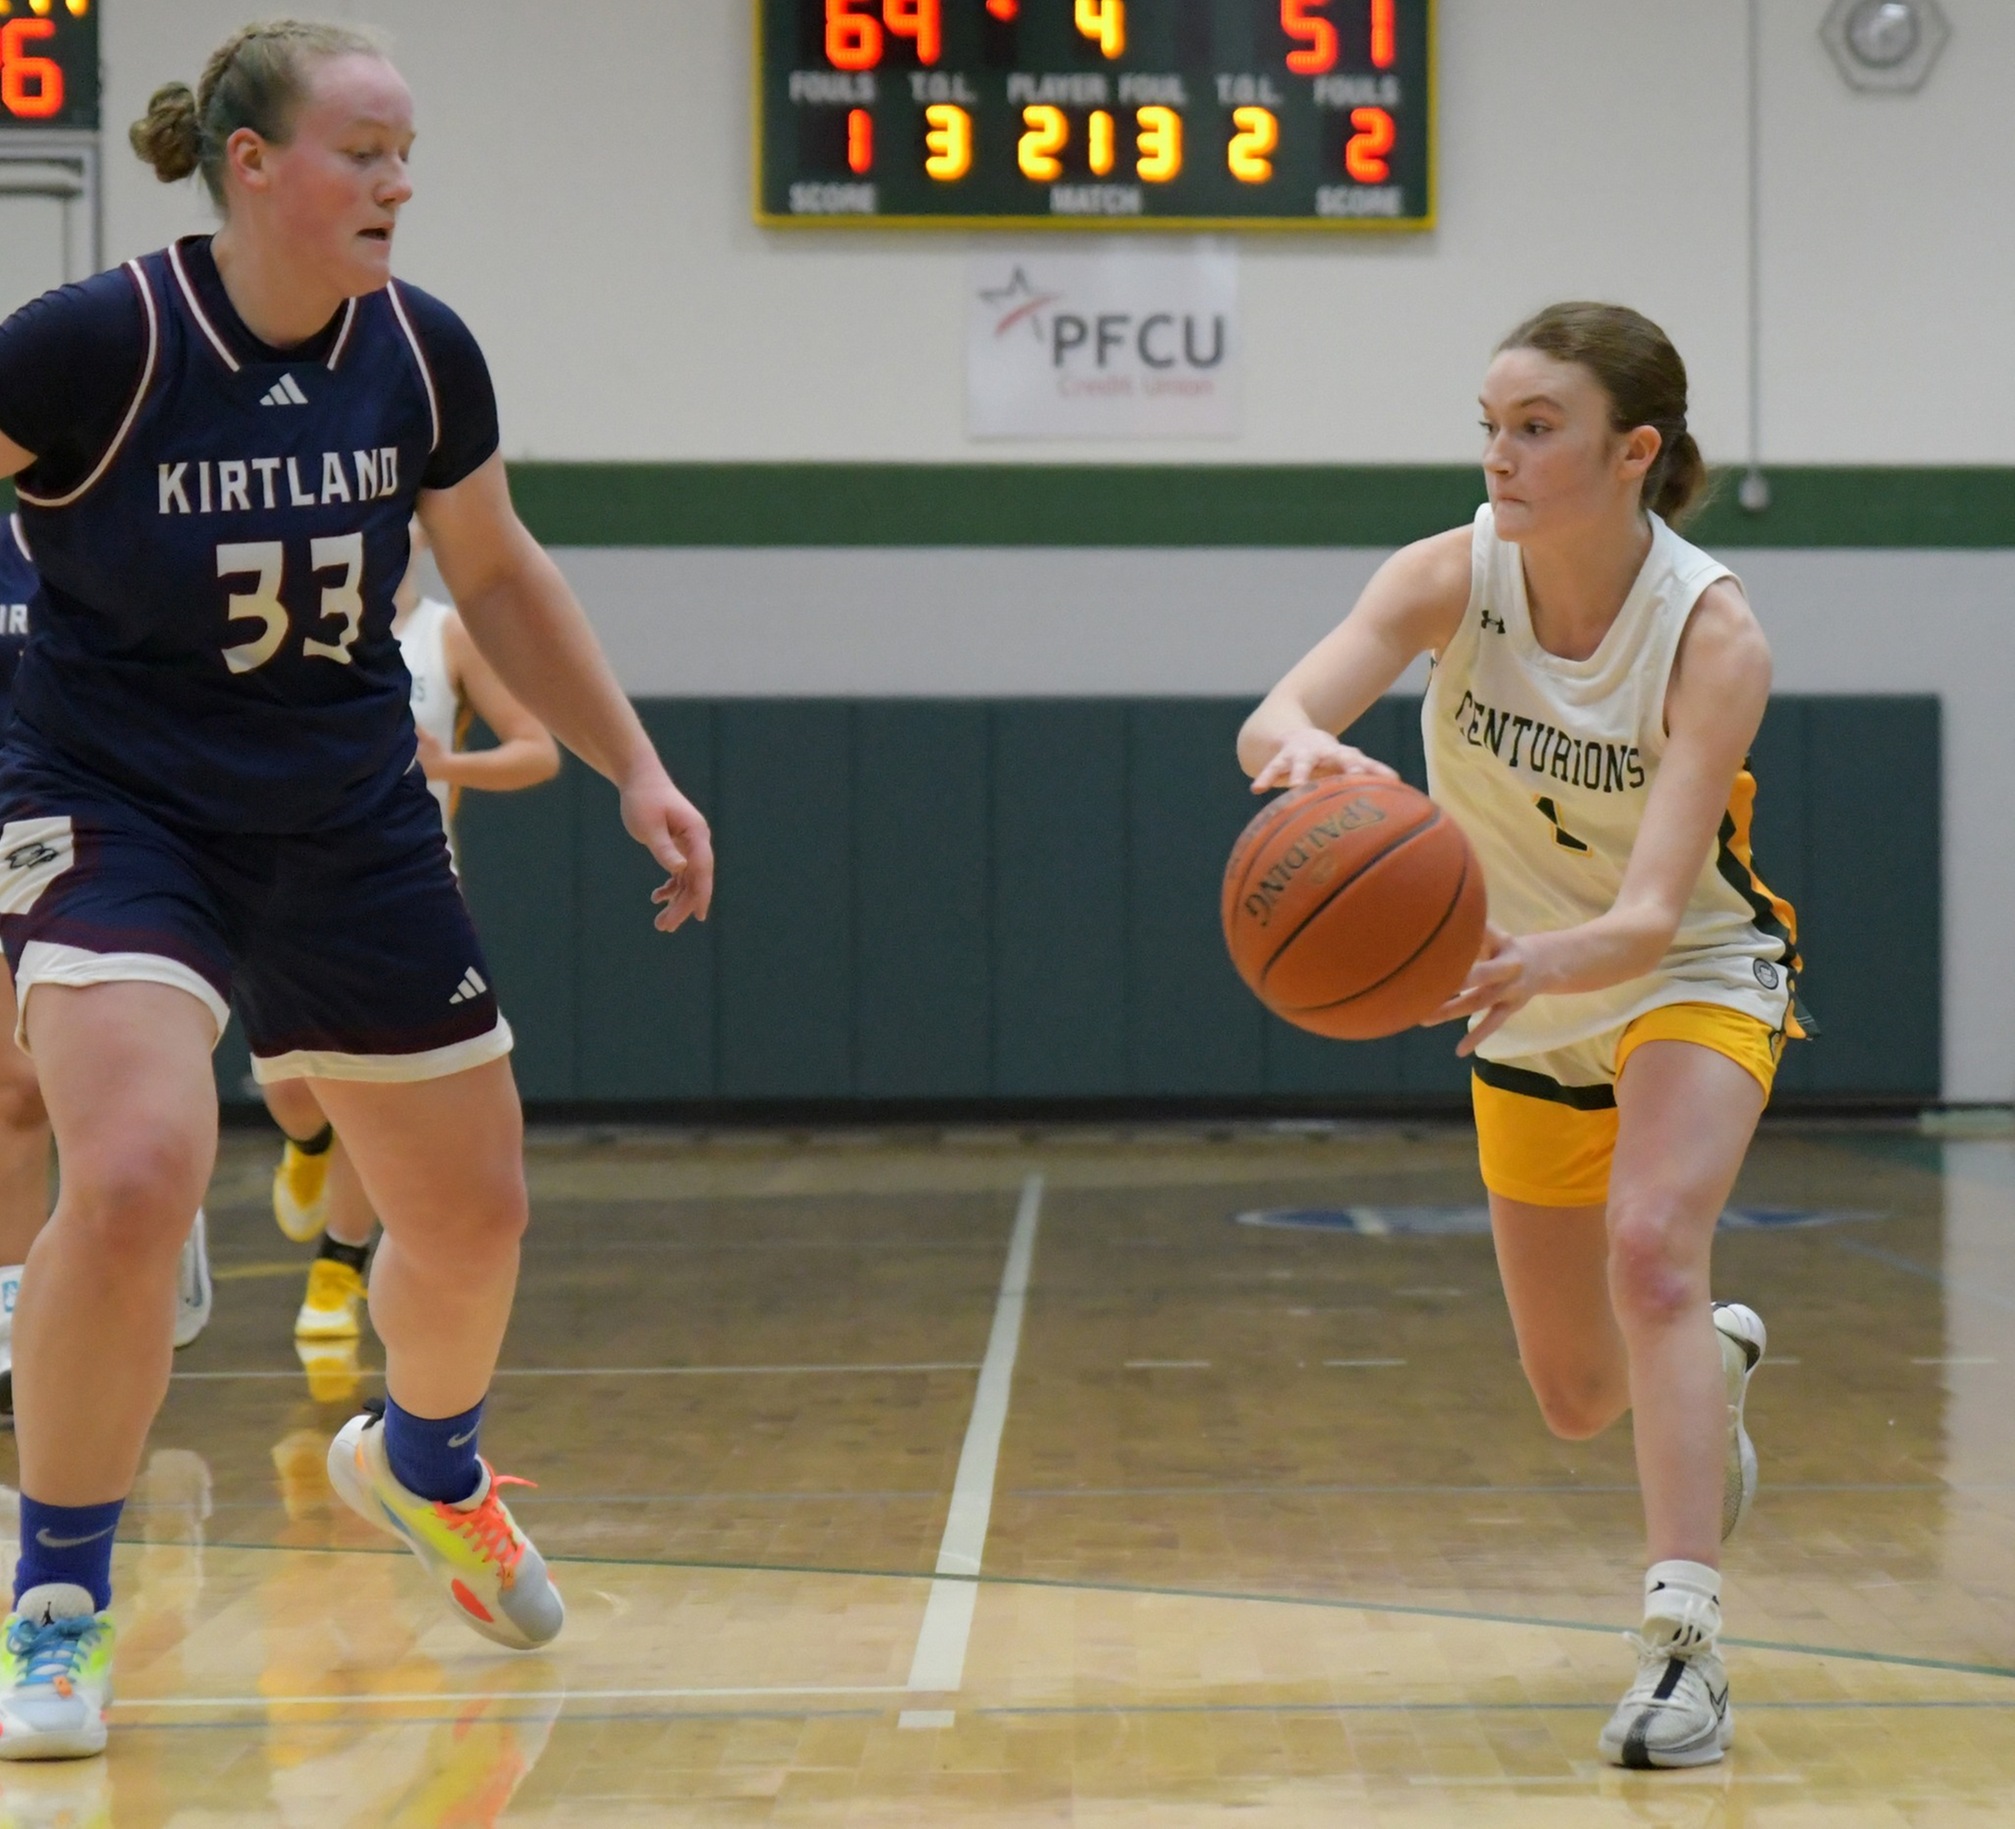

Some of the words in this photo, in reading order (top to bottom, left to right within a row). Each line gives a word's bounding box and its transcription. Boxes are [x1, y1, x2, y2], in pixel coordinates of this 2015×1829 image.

[825, 0, 941, 70] 64
[1074, 0, 1126, 60] 4
[1281, 0, 1395, 74] 51
[1, 17, 64, 118] 6
[789, 70, 876, 104] FOULS
[1006, 73, 1110, 105] PLAYER
[1313, 74, 1399, 107] FOULS
[848, 108, 873, 175] 1
[925, 104, 972, 181] 3
[1228, 105, 1278, 184] 2
[1345, 106, 1395, 183] 2
[789, 182, 876, 214] SCORE
[1049, 183, 1143, 215] MATCH
[1315, 185, 1403, 217] SCORE
[1053, 313, 1225, 370] PFCU
[157, 446, 398, 515] KIRTLAND
[215, 531, 364, 675] 33
[1454, 689, 1646, 793] CENTURIONS
[1244, 796, 1386, 928] SPALDING
